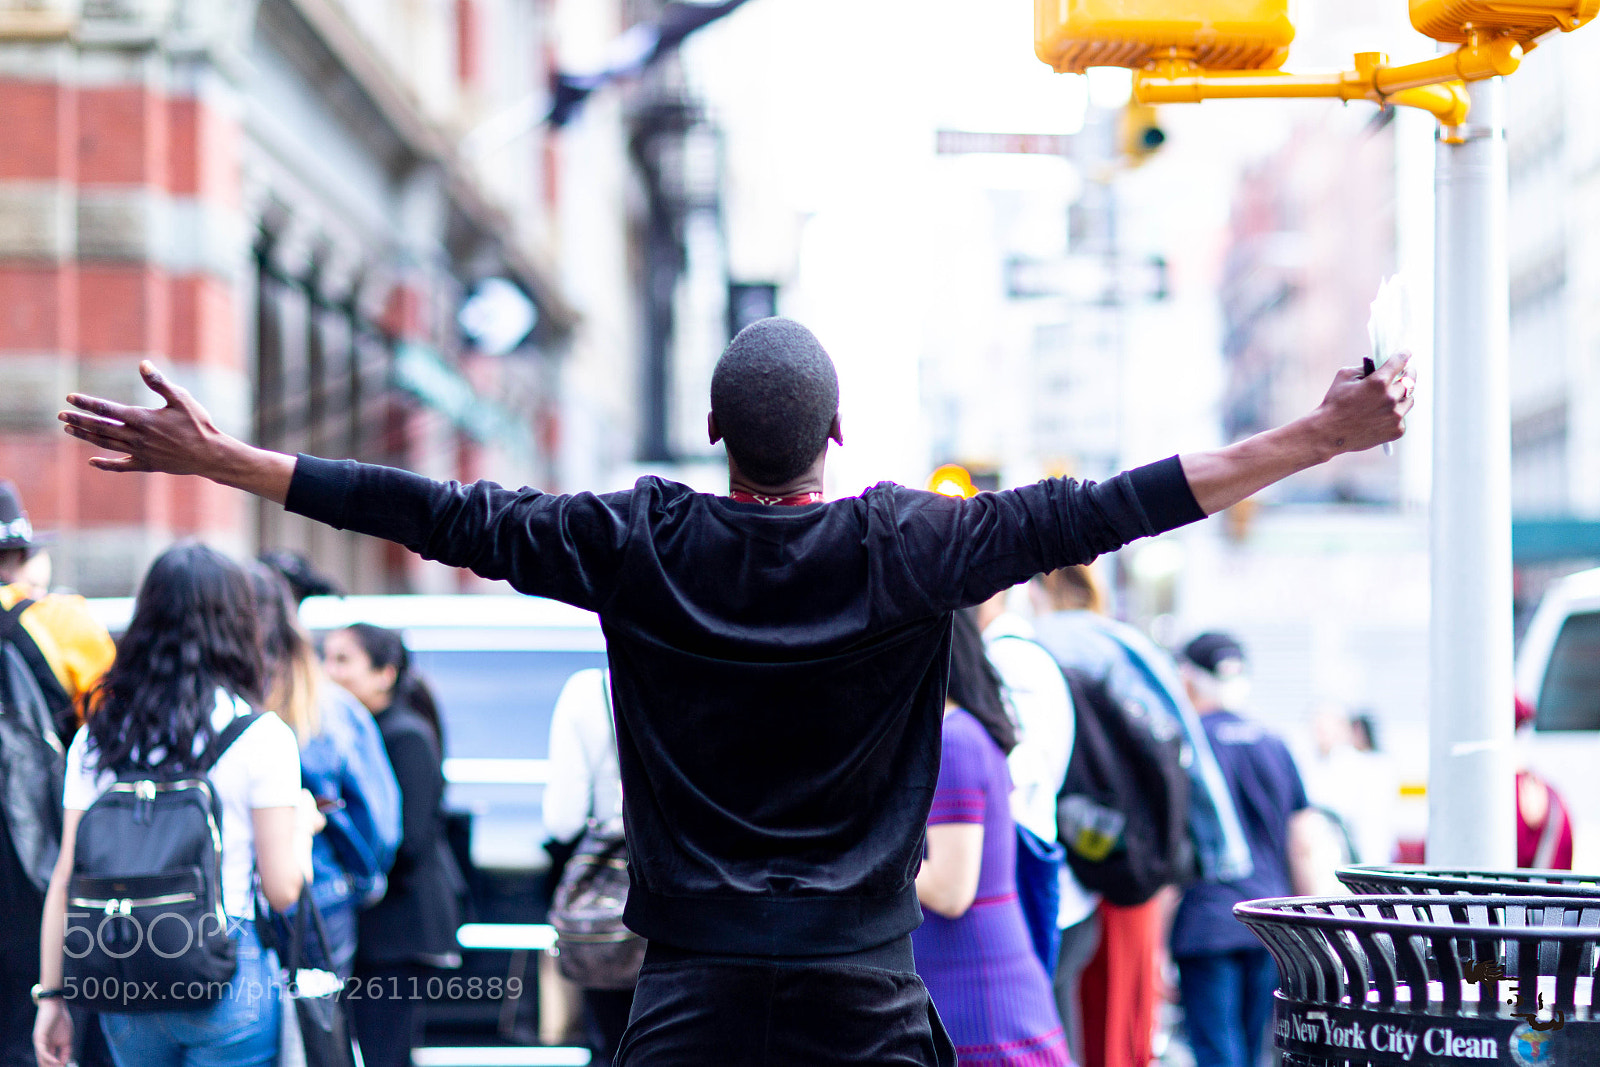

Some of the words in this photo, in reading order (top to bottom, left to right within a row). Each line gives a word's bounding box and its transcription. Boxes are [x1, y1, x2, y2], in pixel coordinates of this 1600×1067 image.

[1291, 1013, 1320, 1044] New
[1321, 1016, 1367, 1050] York
[1370, 1023, 1418, 1061] City
[1423, 1027, 1499, 1059] Clean
